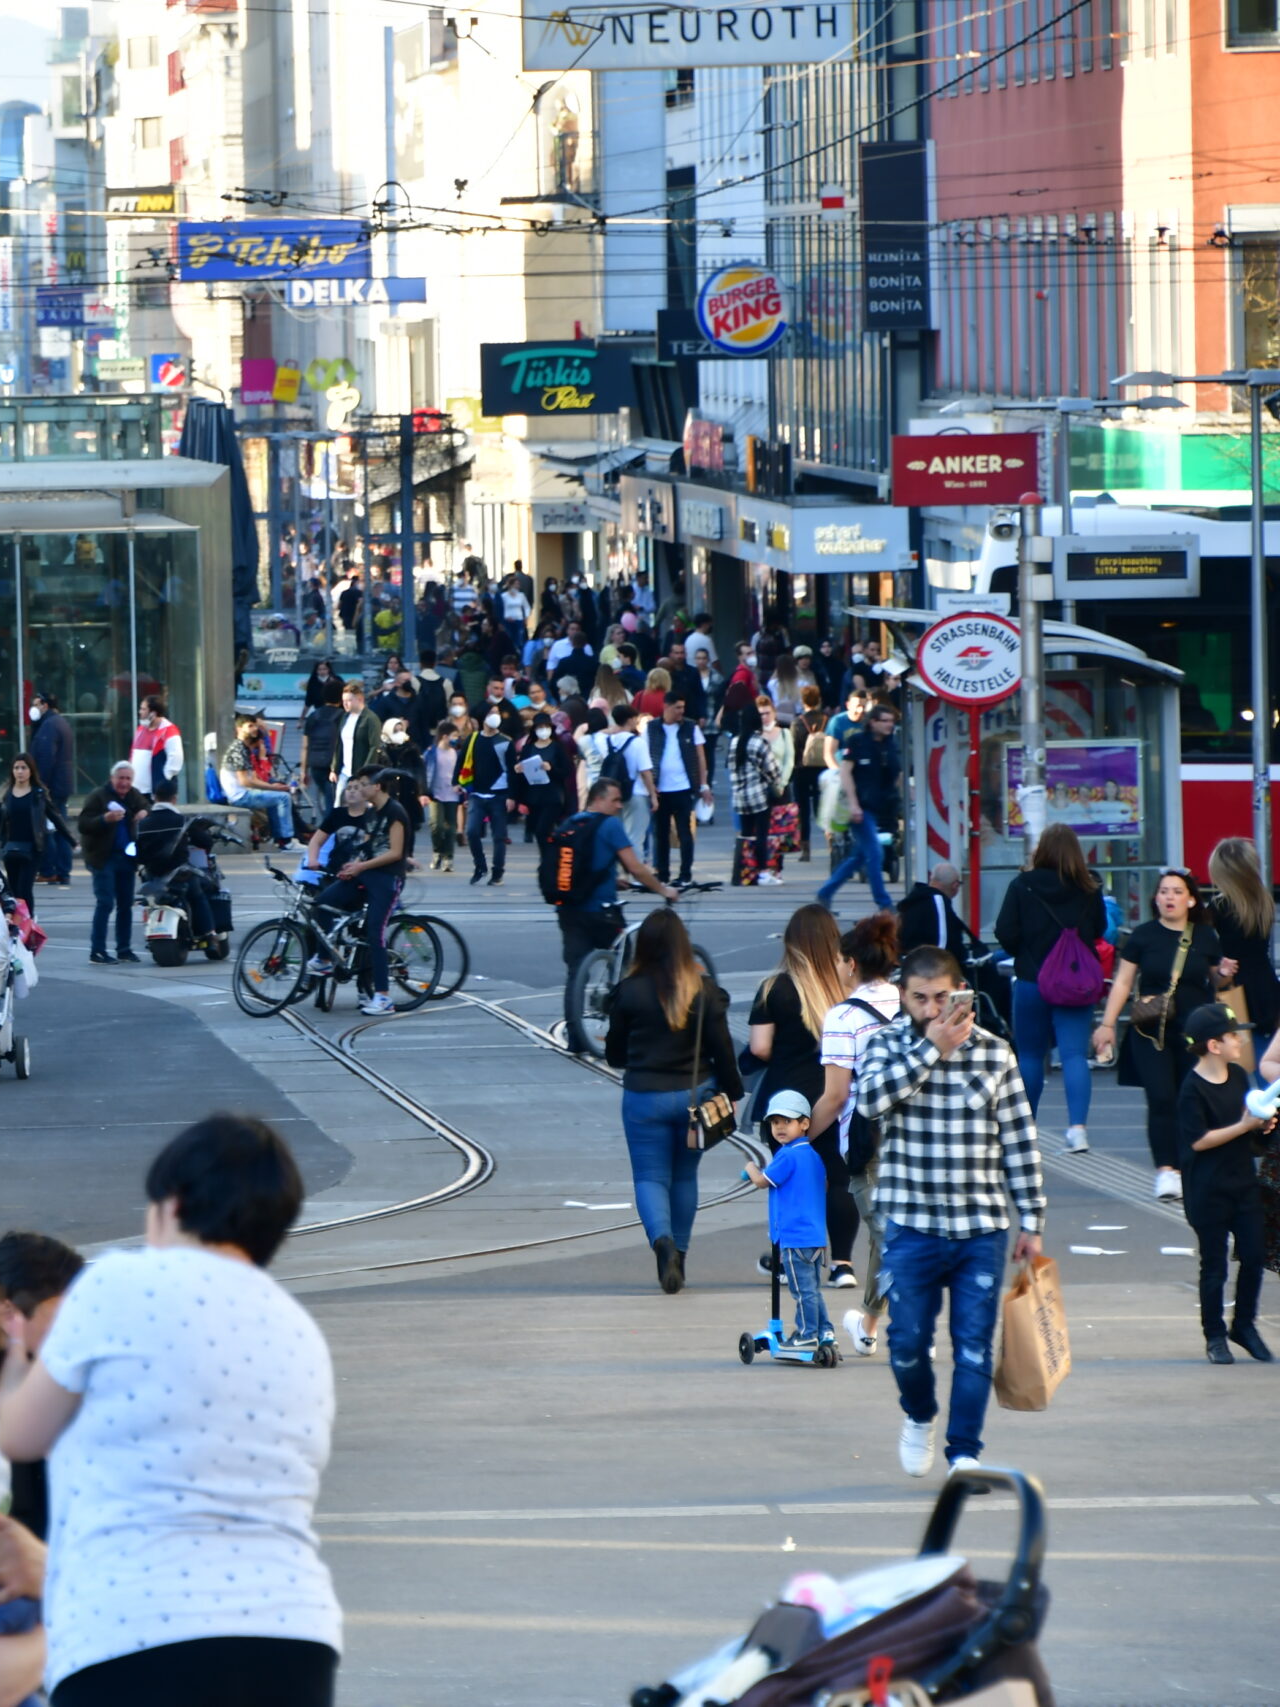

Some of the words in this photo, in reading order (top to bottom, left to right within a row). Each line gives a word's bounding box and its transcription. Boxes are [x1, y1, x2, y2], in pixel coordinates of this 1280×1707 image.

[611, 6, 837, 45] NEUROTH
[227, 236, 358, 267] Tchibo
[292, 280, 389, 306] DELKA
[708, 276, 777, 316] BURGER
[869, 273, 922, 291] BONITA
[712, 293, 782, 339] KING
[870, 297, 923, 314] BONITA
[500, 348, 598, 393] Türkis
[928, 455, 1002, 474] ANKER
[543, 508, 586, 530] pimkie
[930, 623, 1020, 653] STRASSENBAHN
[934, 667, 1016, 693] HALTESTELLE
